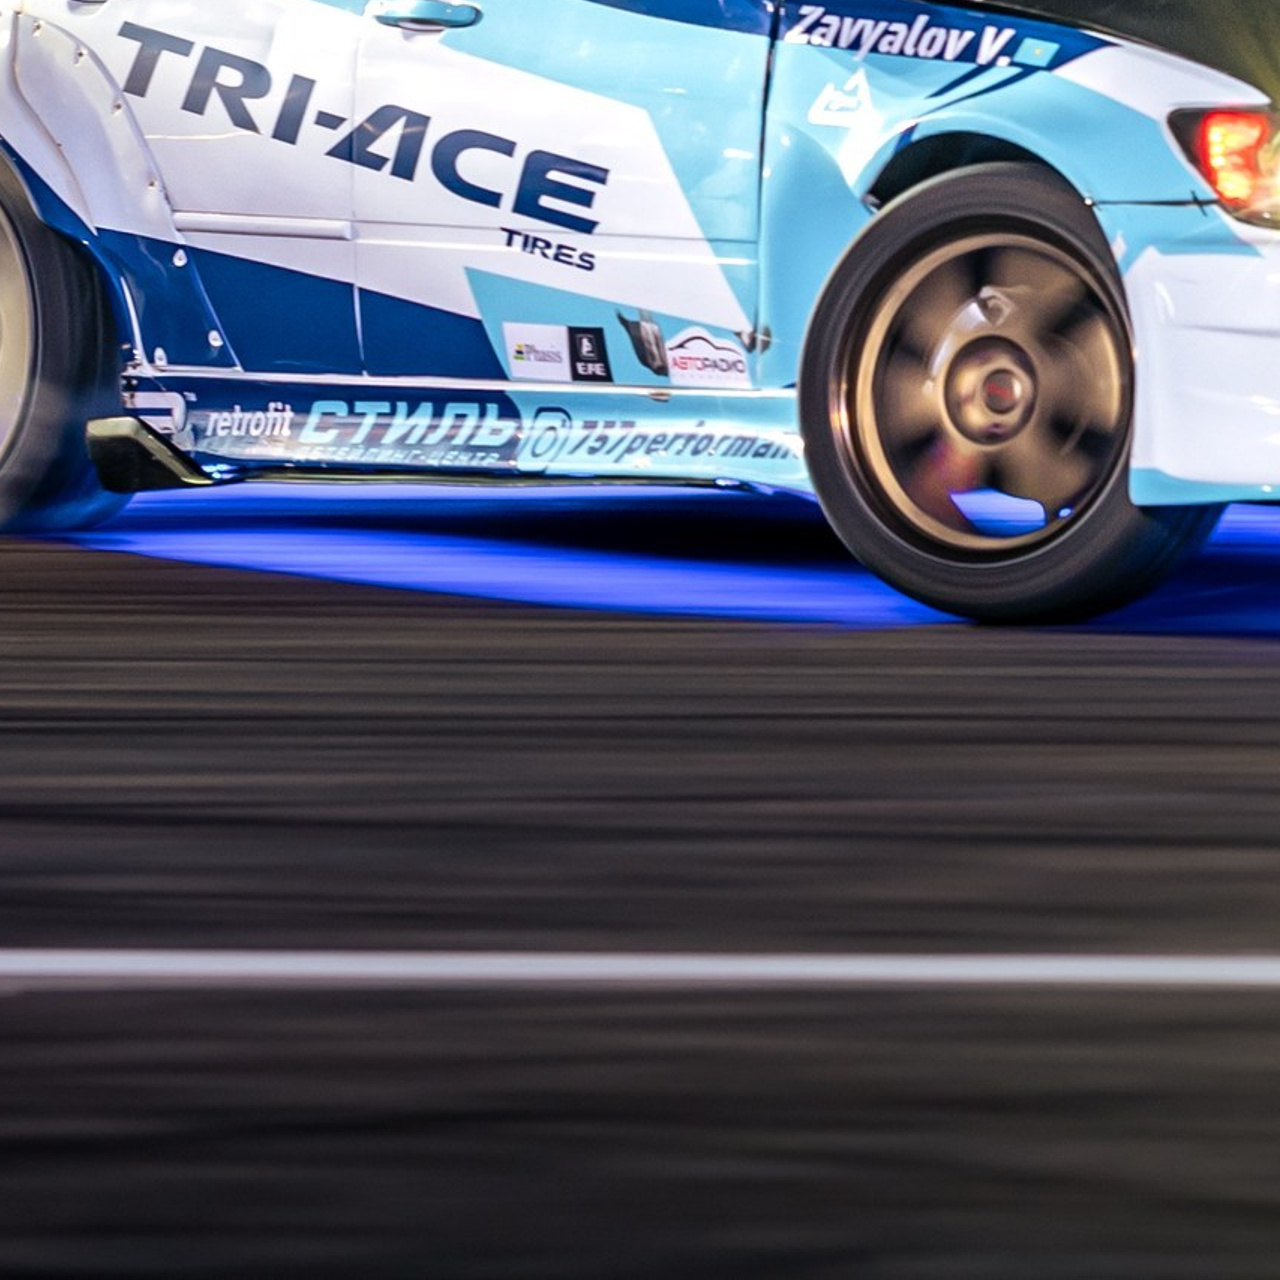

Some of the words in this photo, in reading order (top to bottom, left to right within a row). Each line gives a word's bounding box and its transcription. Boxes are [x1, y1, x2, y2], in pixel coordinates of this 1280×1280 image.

[783, 4, 976, 62] Zavyalov
[976, 25, 1017, 67] V.
[116, 20, 610, 235] TRI-ACE
[500, 227, 597, 272] TIRES
[204, 400, 295, 439] retrofit
[298, 399, 518, 447] СТИЛЬ
